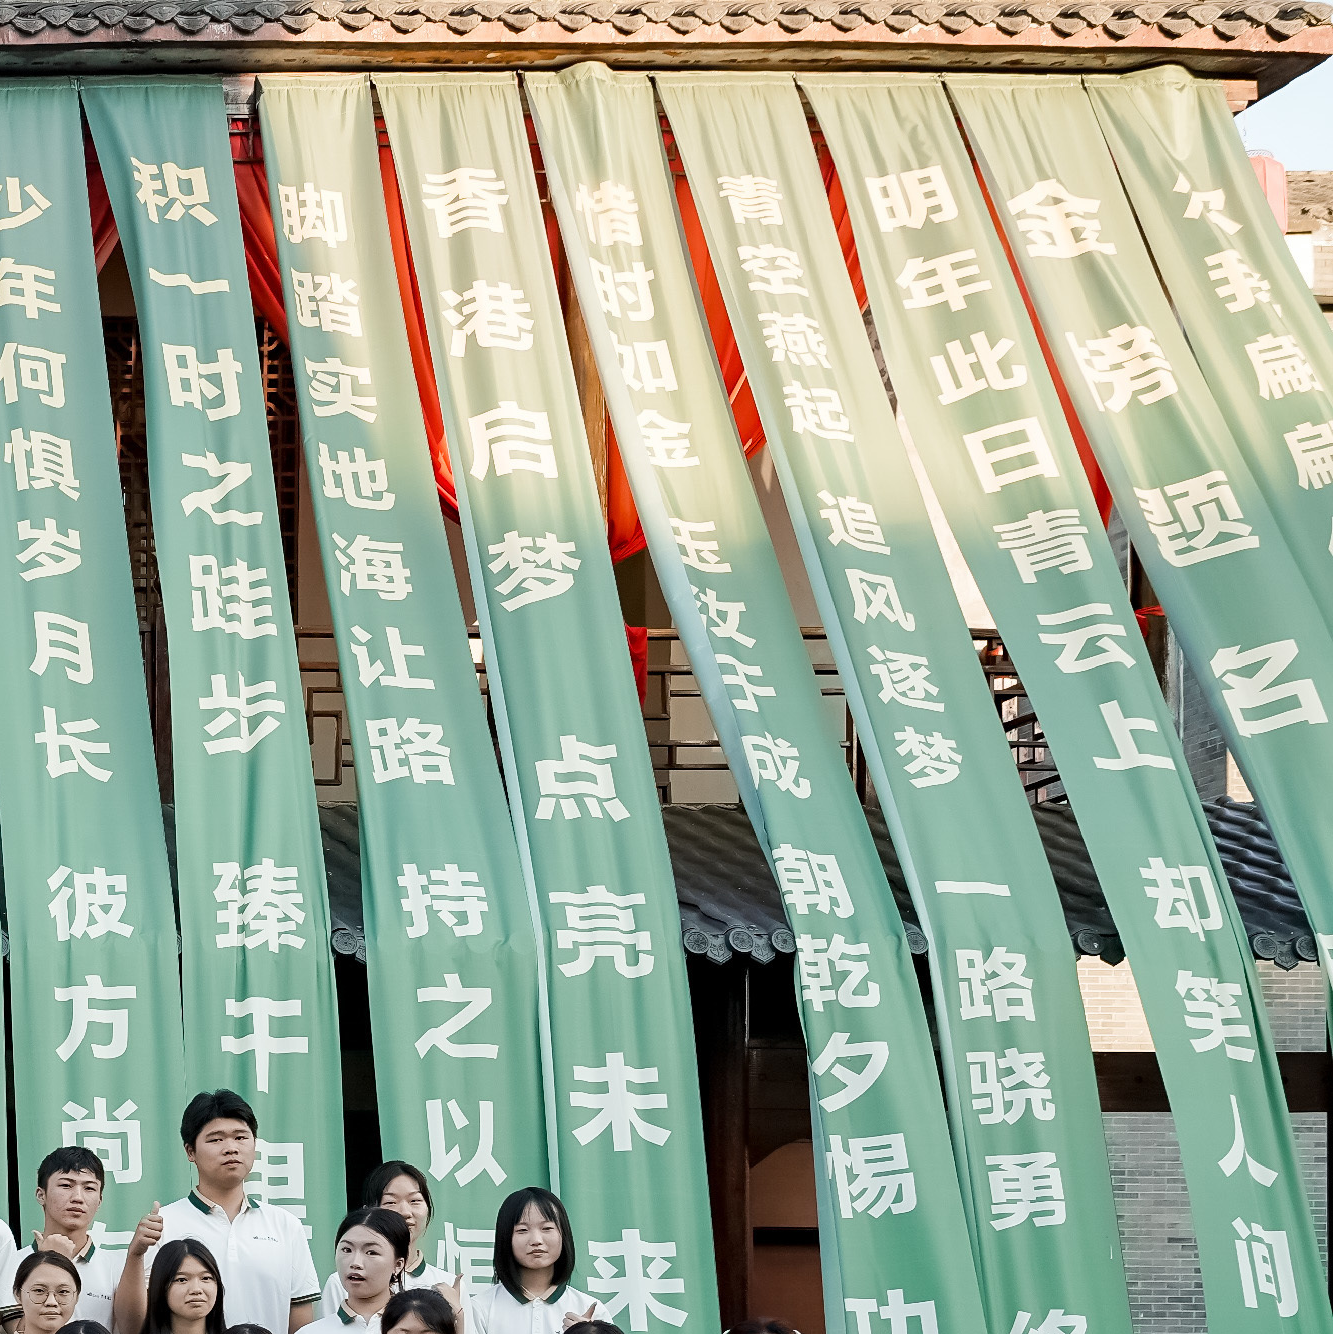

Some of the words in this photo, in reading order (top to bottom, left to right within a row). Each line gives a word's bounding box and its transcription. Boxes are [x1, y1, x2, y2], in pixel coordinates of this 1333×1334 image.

[131, 157, 285, 757] 积一时之跬步
[277, 182, 455, 787] 脚踏实地海让路
[422, 167, 580, 612] 香港启梦
[864, 164, 1175, 772] 明年此日青云上
[1006, 178, 1329, 738] 金榜题名
[576, 180, 700, 468] 惜时如金
[771, 843, 916, 1220] 朝乾夕惕
[717, 174, 854, 443] 青空燕起
[819, 489, 963, 789] 追风逐梦
[933, 878, 1067, 1231] 一路骁勇
